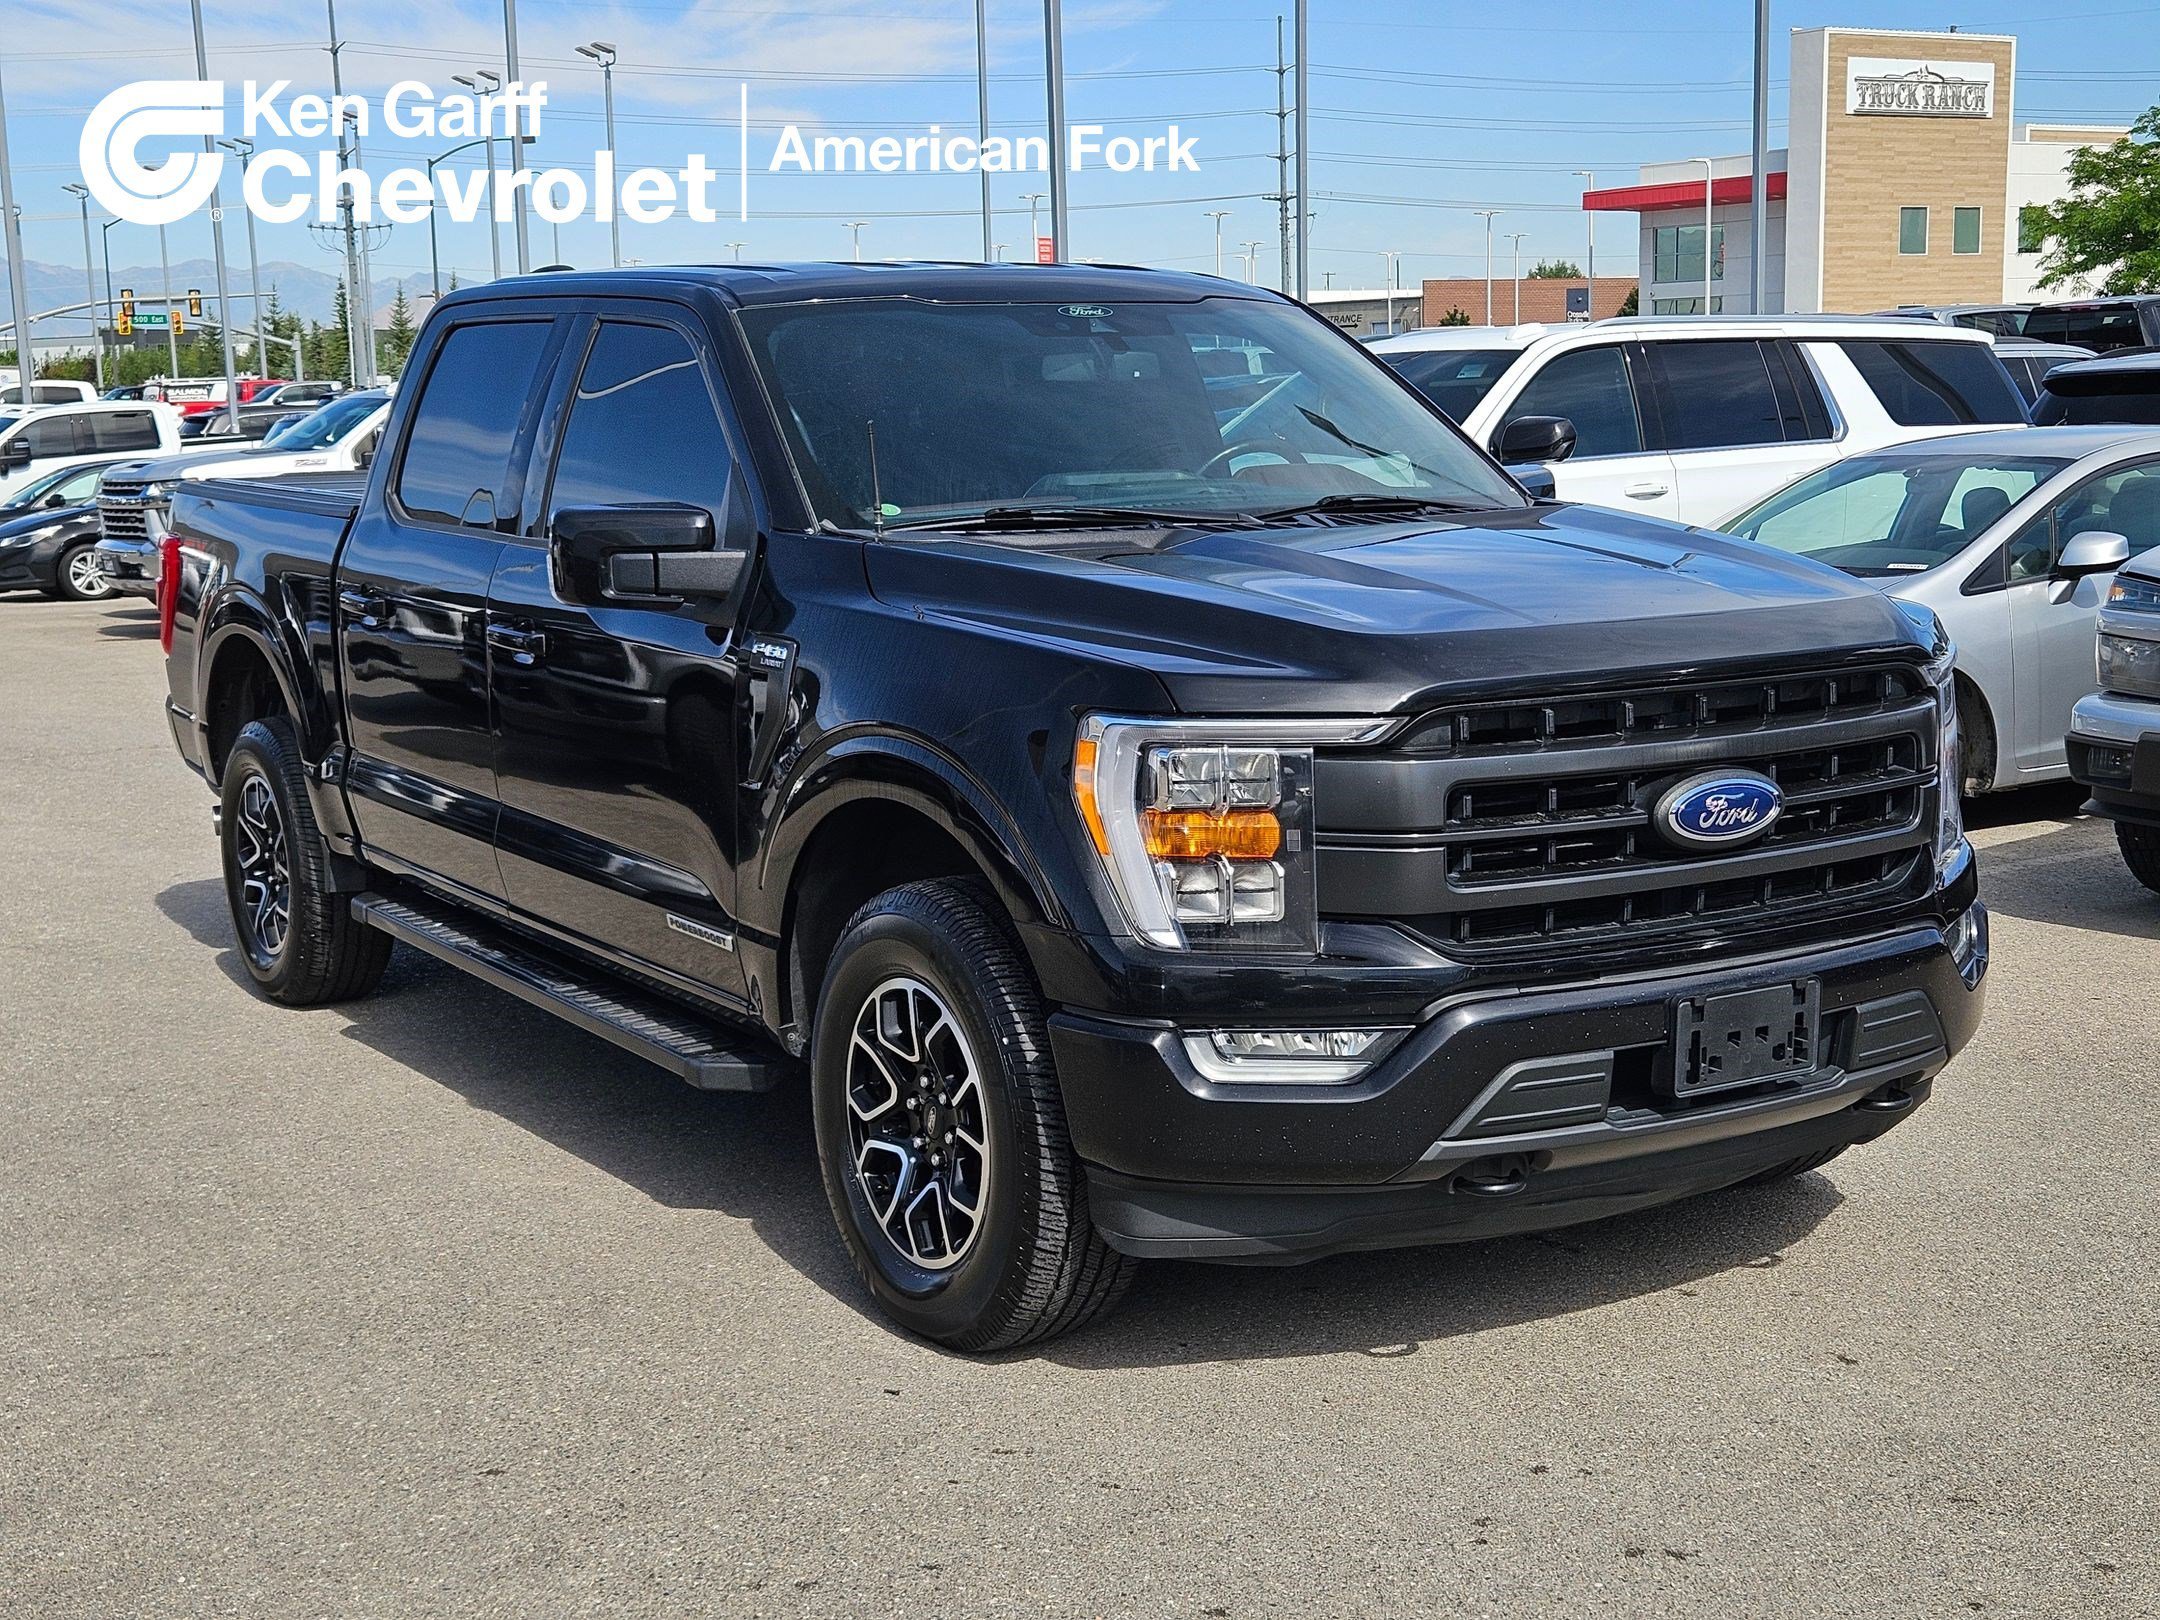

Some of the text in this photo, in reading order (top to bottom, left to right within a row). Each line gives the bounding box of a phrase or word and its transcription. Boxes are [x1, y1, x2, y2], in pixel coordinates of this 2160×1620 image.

[1857, 82, 1986, 110] TRUCK RANCH
[1069, 306, 1104, 316] Ford
[1328, 314, 1362, 323] TRANCE
[1699, 793, 1759, 829] Ford
[669, 917, 727, 946] POWERBOOST
